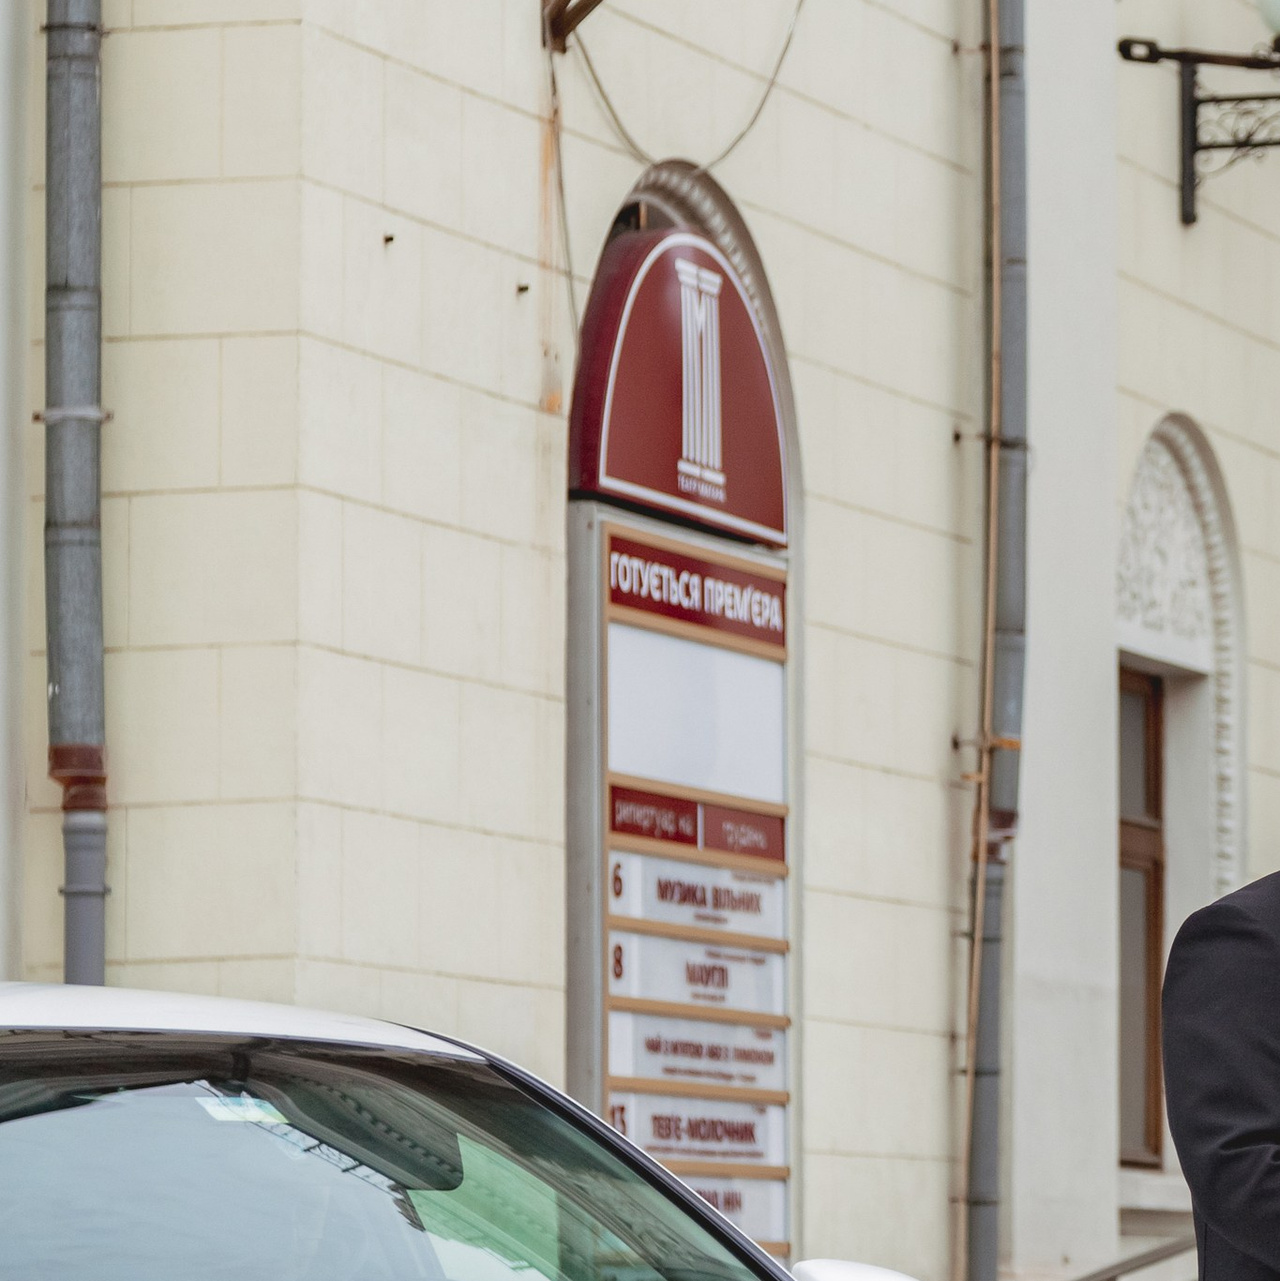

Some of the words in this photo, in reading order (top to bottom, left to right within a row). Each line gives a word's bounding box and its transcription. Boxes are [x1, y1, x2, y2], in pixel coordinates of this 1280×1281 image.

[610, 551, 702, 611] ГОТУЄТЬСЯ
[612, 863, 623, 898] 6
[657, 877, 707, 908] МУЗИКА
[712, 885, 762, 914] ВІЛЬНИХ
[613, 944, 623, 979] 8
